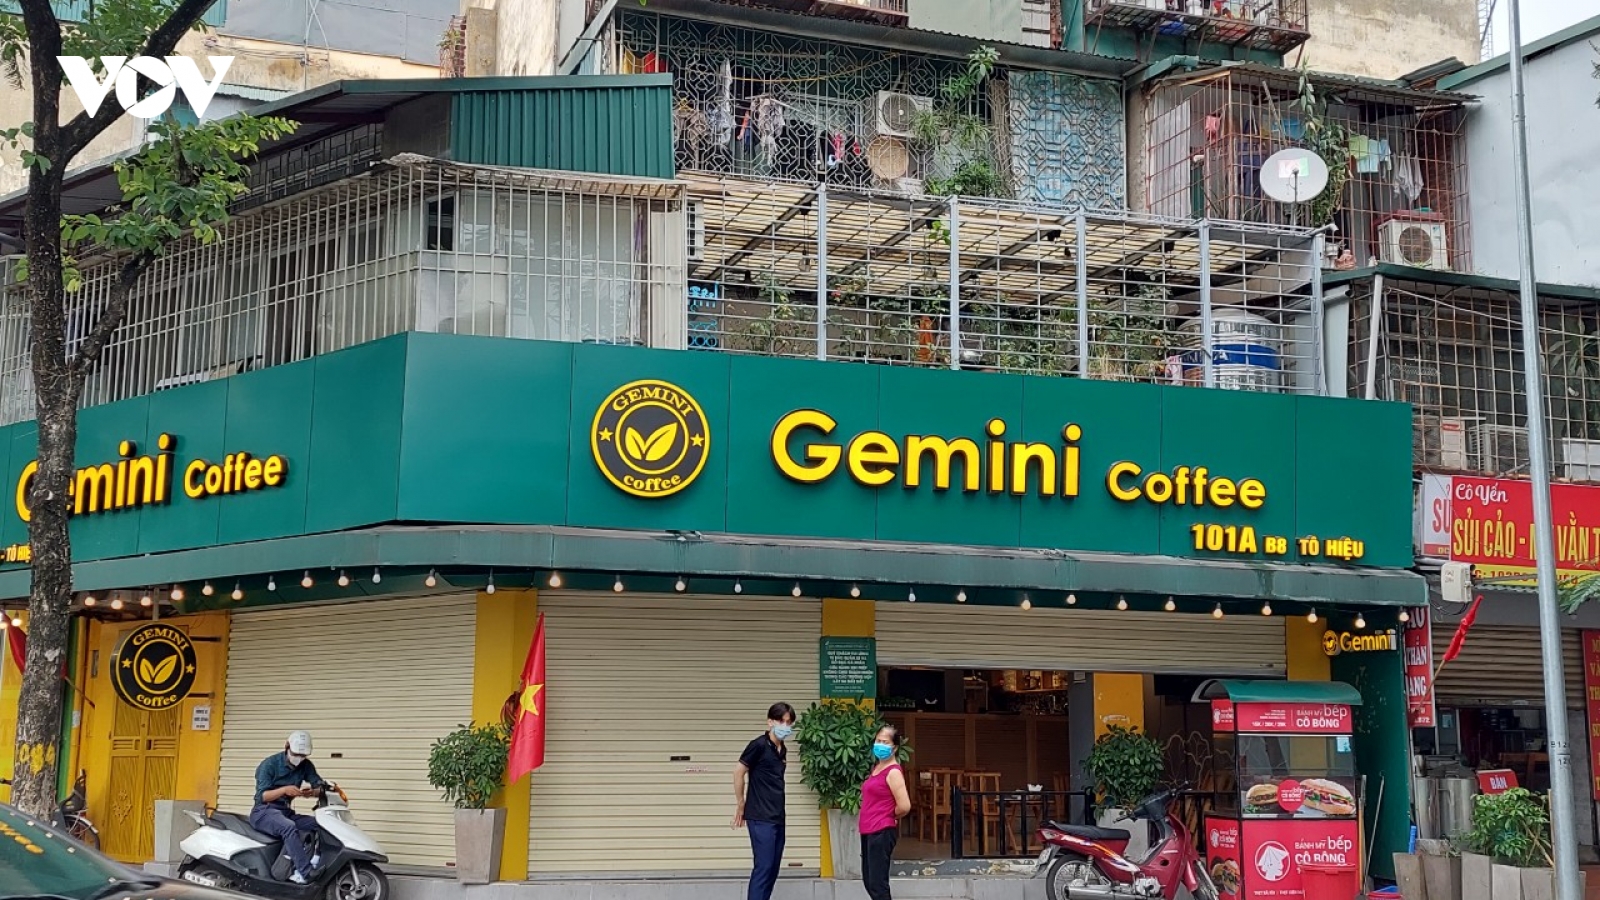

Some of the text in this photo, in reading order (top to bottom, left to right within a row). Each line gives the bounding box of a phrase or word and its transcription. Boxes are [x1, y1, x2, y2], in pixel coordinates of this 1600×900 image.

[612, 387, 694, 417] GEMINI
[770, 408, 1267, 509] Gemini Coffee
[184, 452, 285, 498] Coffee
[623, 475, 682, 491] coffee
[1455, 482, 1509, 506] Cô Yến
[1191, 523, 1365, 561] 101A B8 TÔ HIỆU
[1453, 507, 1480, 556] SỦI
[1484, 509, 1516, 559] CẢO
[1557, 511, 1590, 562] VẰN
[132, 628, 190, 651] GEMINI
[1340, 629, 1397, 651] Gemini
[136, 694, 177, 706] coffee
[1296, 716, 1311, 728] CÔ
[1312, 716, 1340, 728] BÔNG
[1294, 838, 1315, 849] BÁNH
[1327, 835, 1352, 853] bếp
